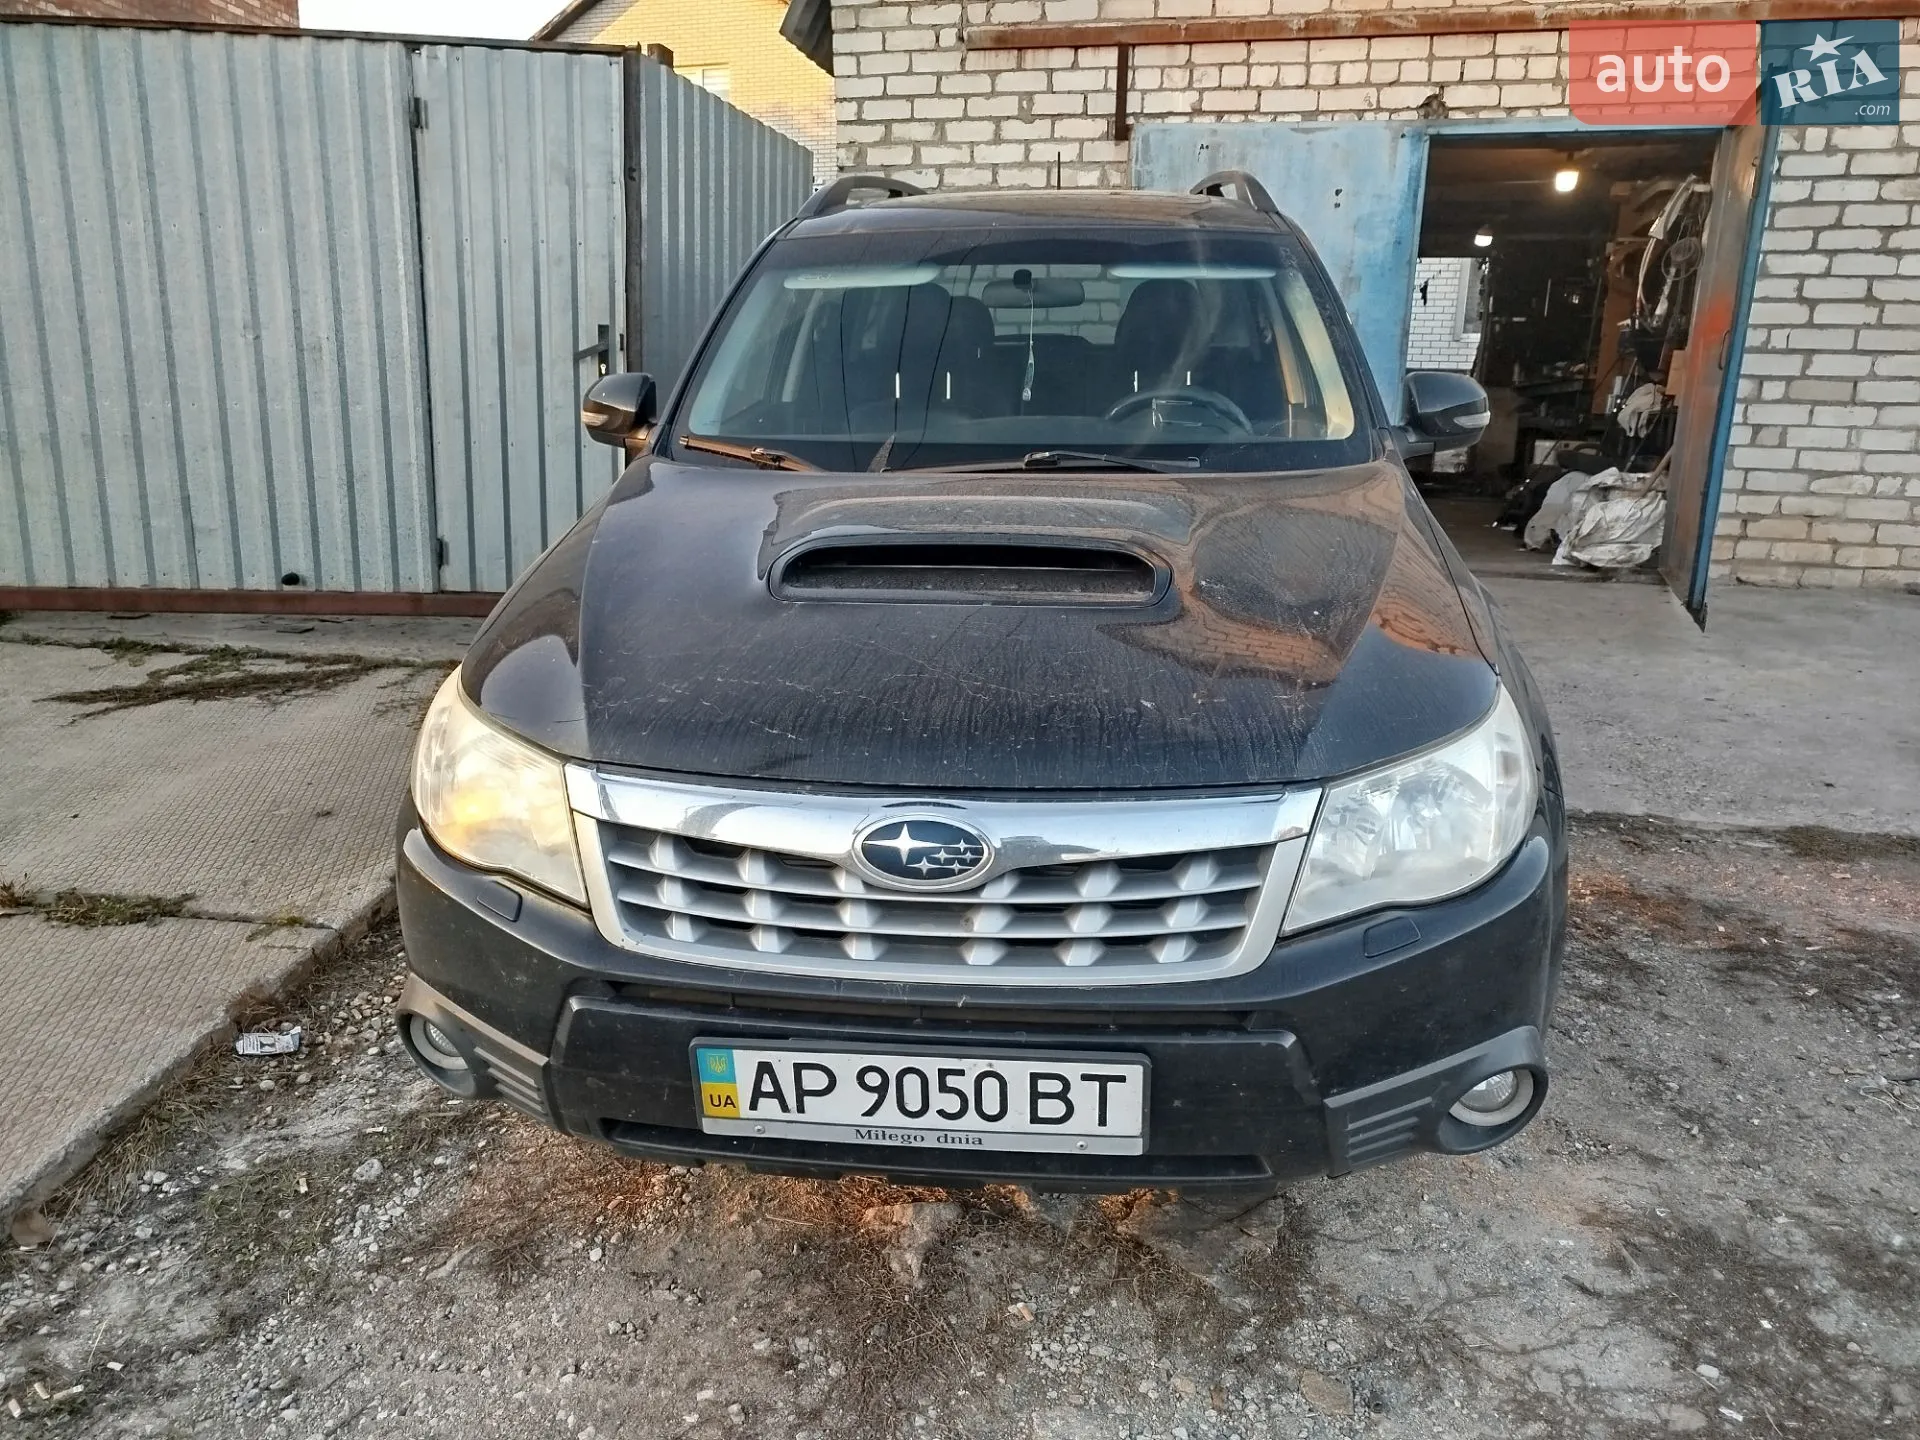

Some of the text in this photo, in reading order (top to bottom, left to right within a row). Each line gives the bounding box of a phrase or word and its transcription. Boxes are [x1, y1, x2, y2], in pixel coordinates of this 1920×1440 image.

[709, 1094, 737, 1109] UA
[748, 1061, 1128, 1127] AP 9050 BT
[936, 1133, 984, 1146] dnia
